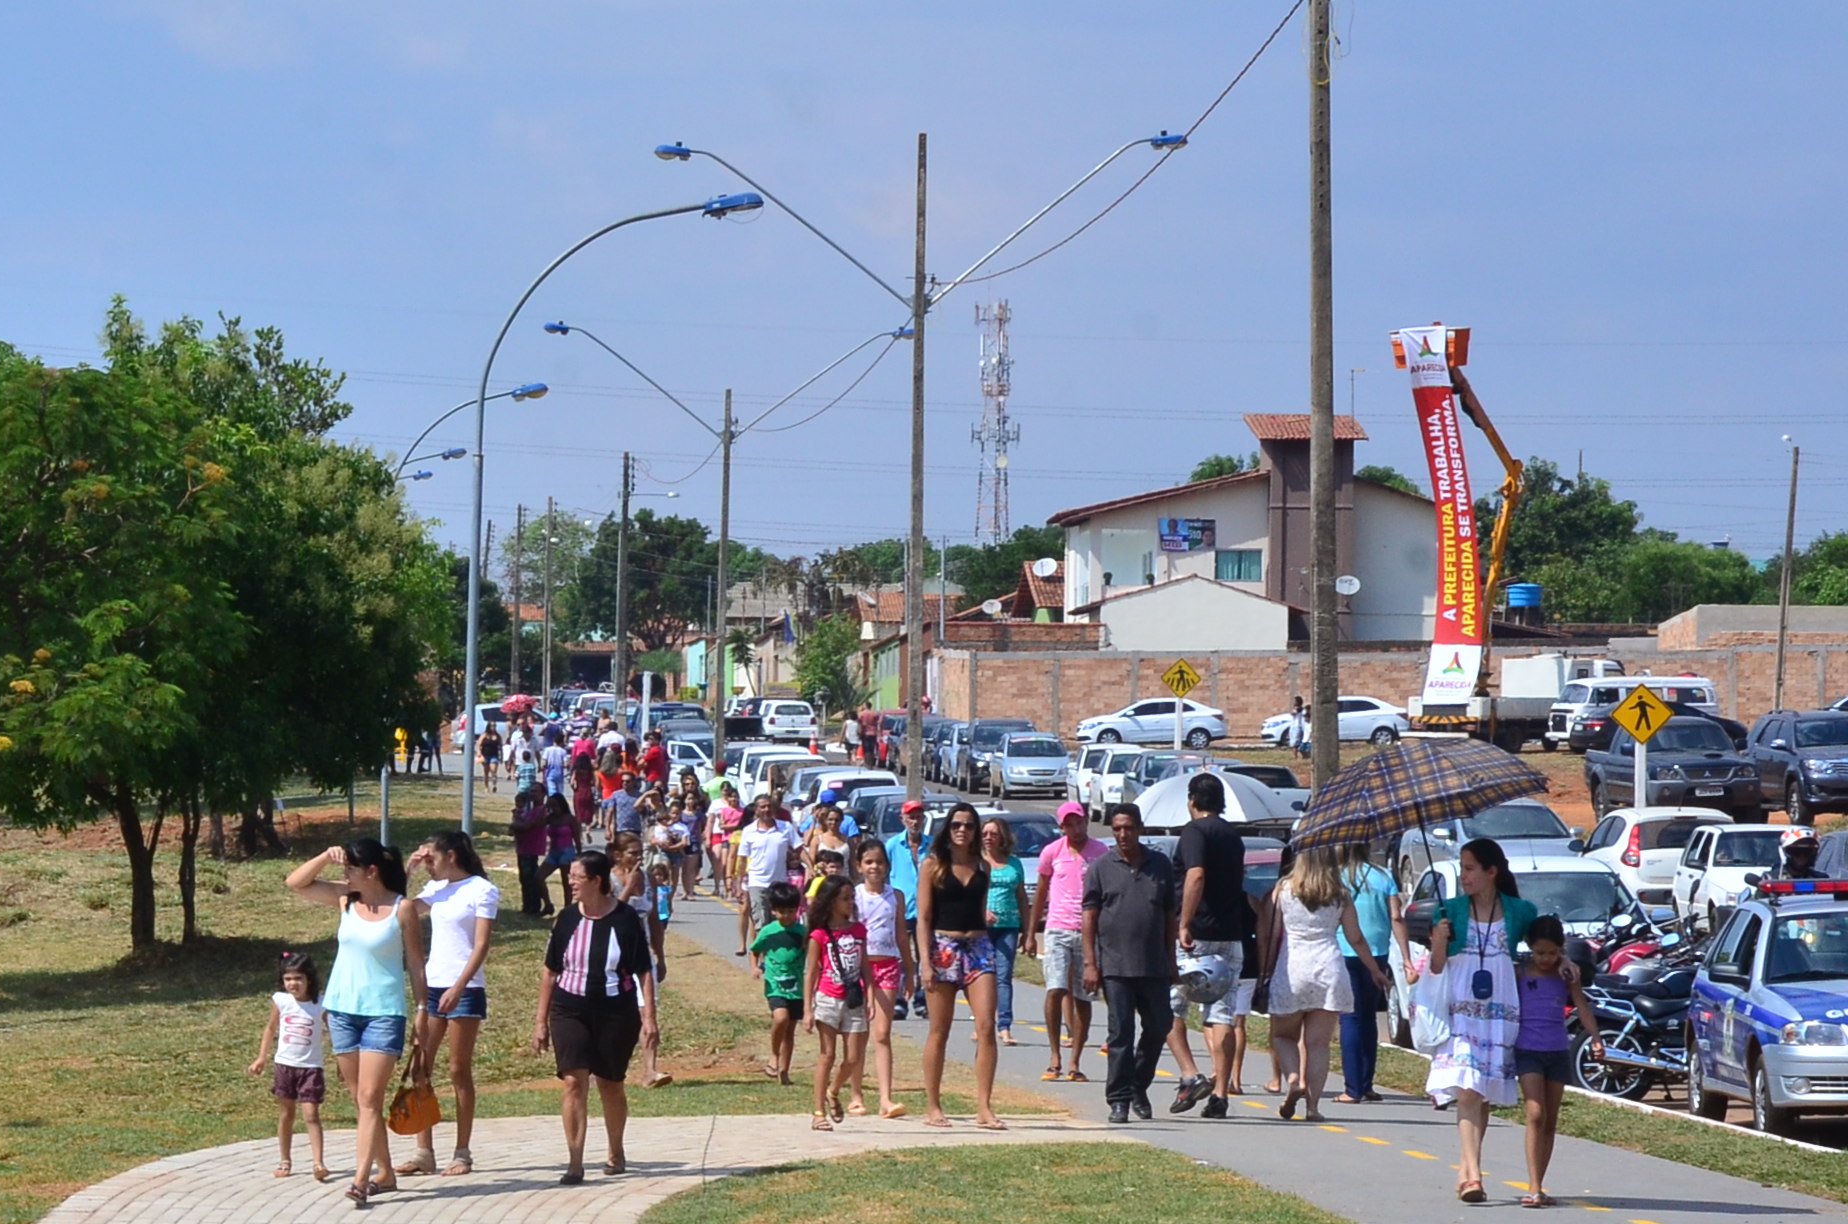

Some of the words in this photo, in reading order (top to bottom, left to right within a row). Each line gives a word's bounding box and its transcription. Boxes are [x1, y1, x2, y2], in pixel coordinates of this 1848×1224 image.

[1427, 408, 1452, 499] TRABALHA,
[1441, 394, 1469, 512] TRANSFORMA.
[1441, 502, 1457, 605] PREFEITURA
[1458, 515, 1471, 537] SE
[1443, 608, 1457, 621] A
[1461, 540, 1475, 637] APARECIDA
